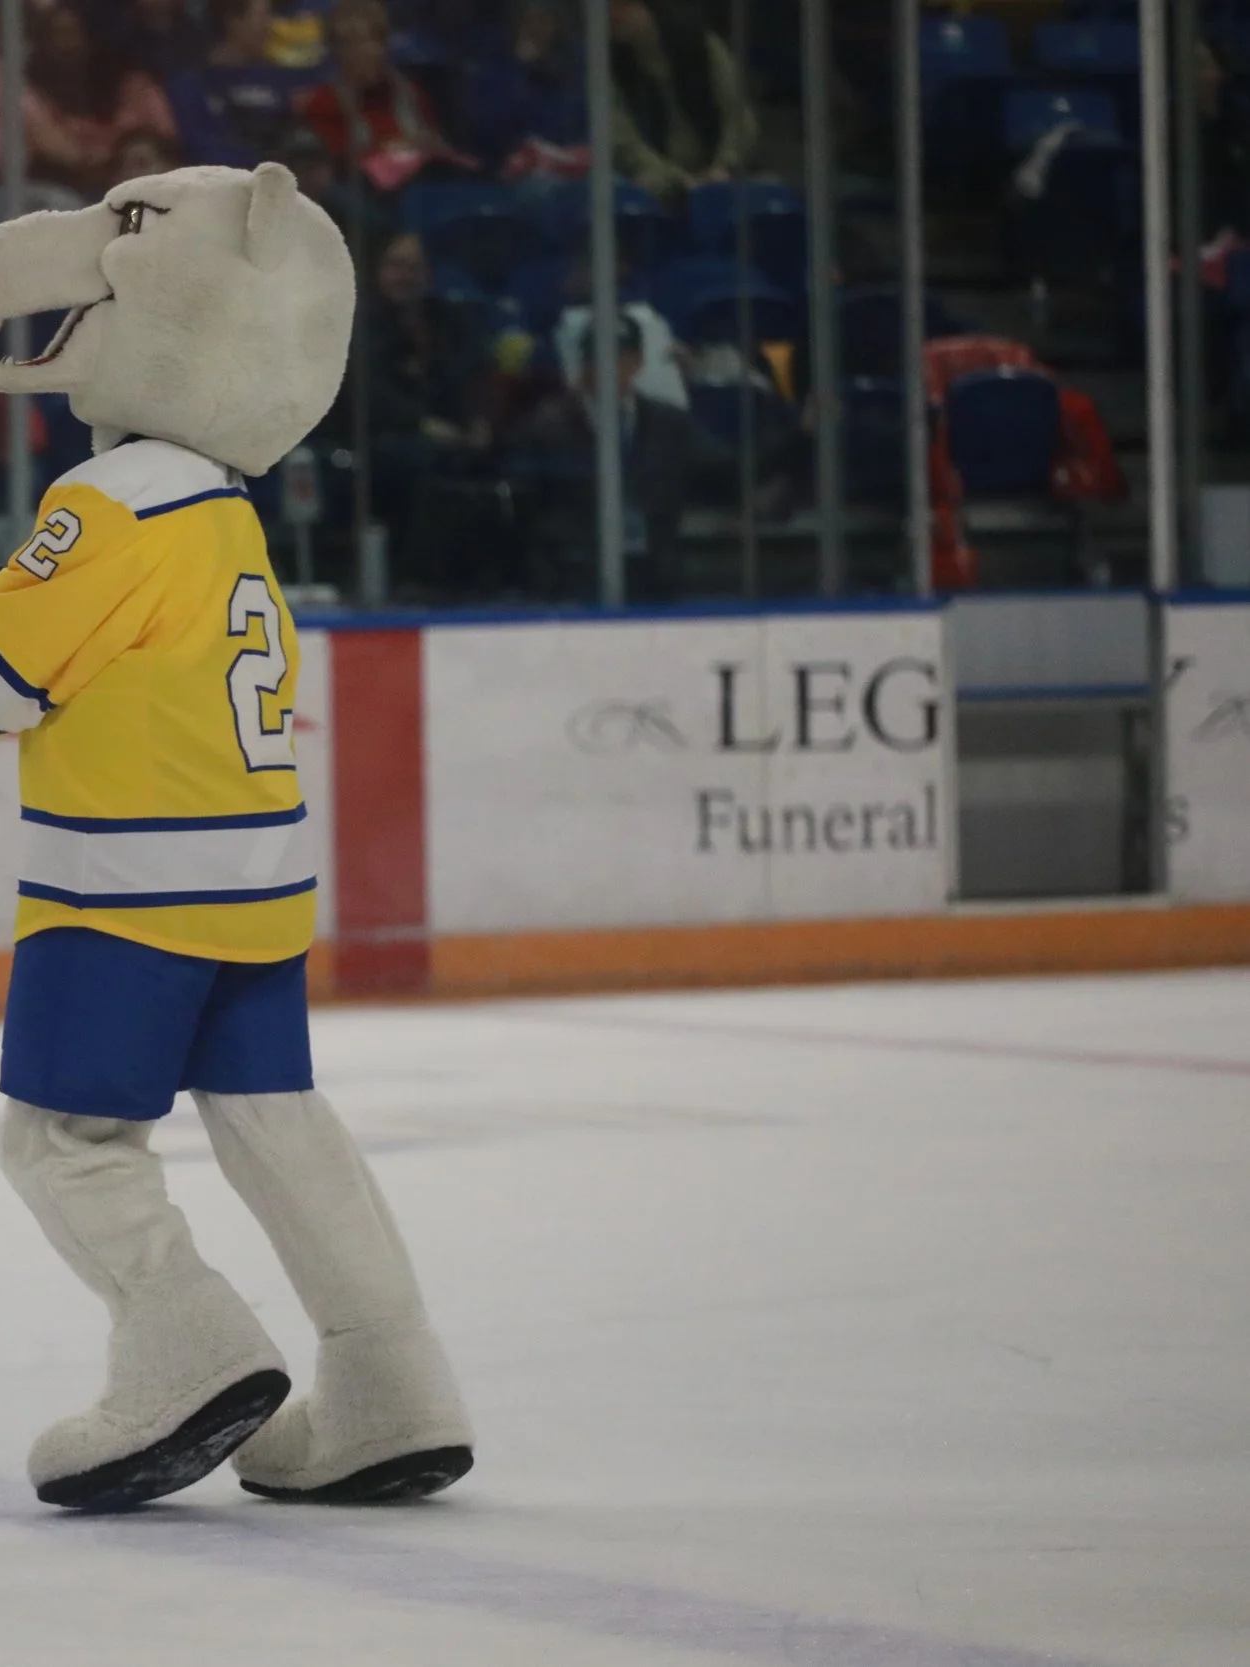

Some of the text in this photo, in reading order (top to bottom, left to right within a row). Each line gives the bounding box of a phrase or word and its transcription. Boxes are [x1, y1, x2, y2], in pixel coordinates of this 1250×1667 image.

[15, 507, 83, 581] 2
[225, 572, 297, 774] 2
[692, 783, 938, 854] Funeral
